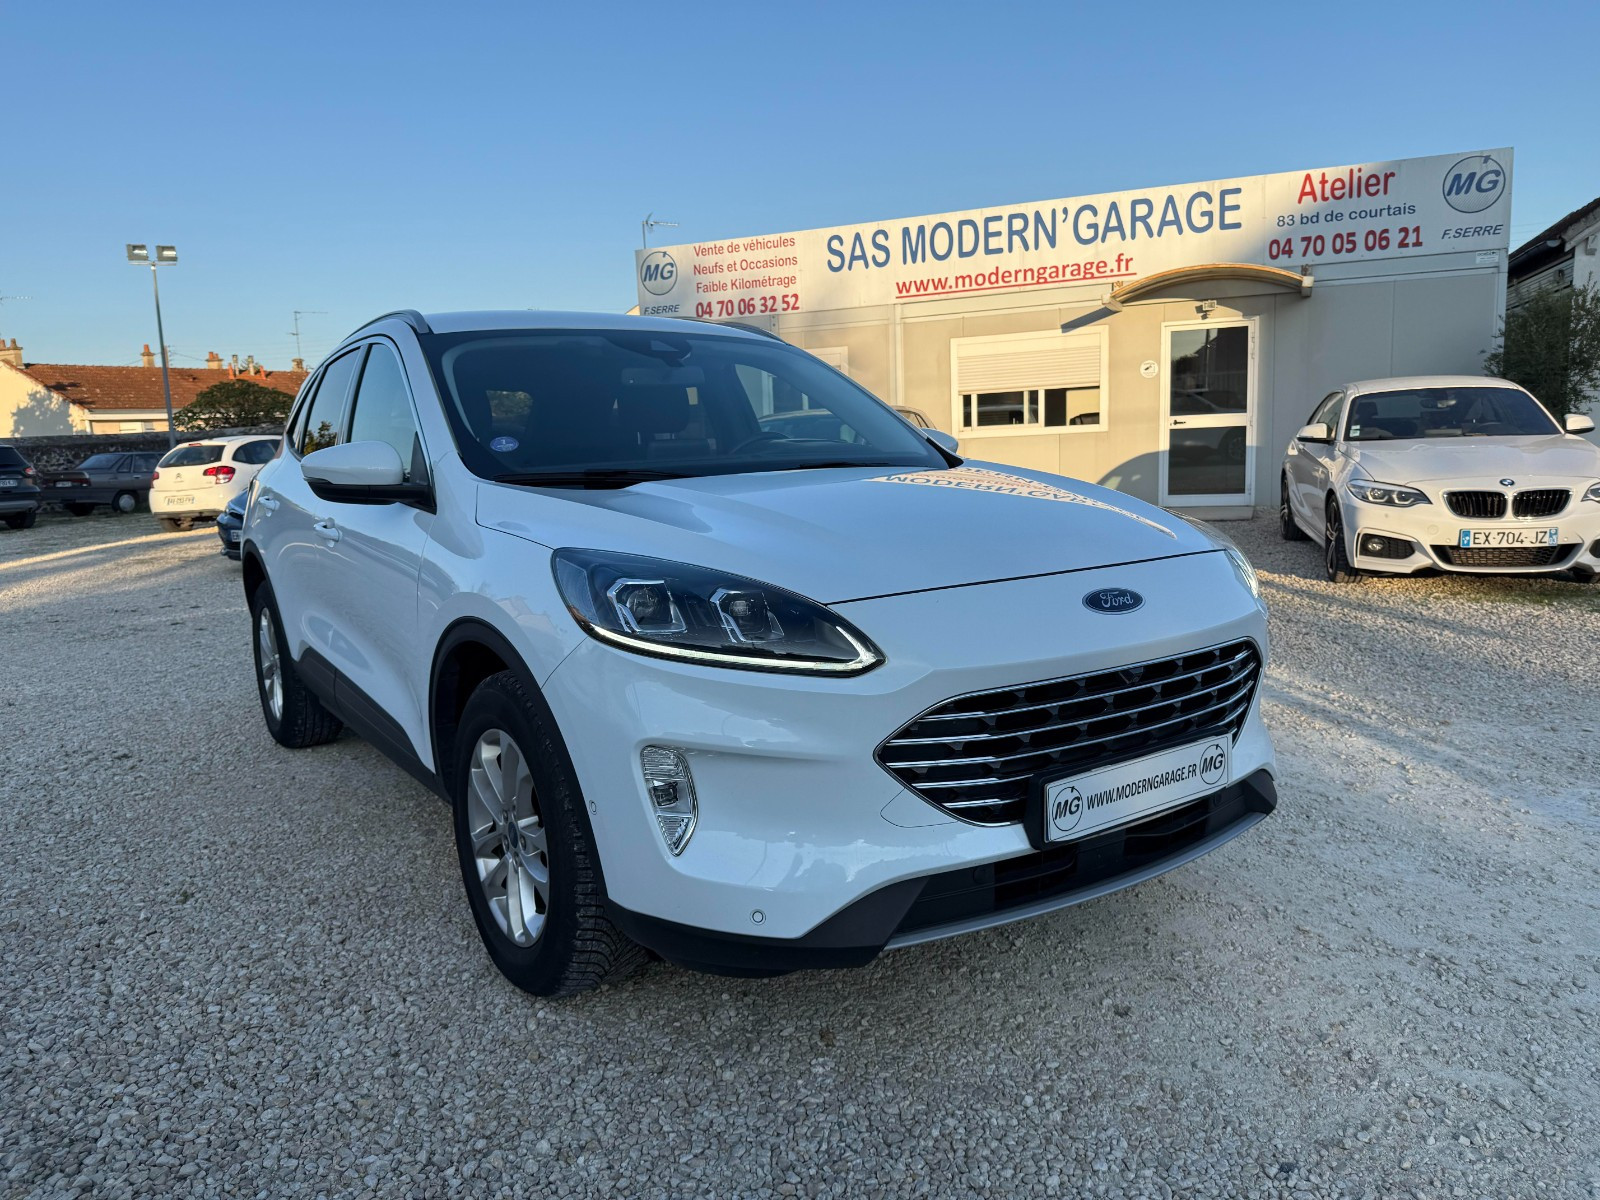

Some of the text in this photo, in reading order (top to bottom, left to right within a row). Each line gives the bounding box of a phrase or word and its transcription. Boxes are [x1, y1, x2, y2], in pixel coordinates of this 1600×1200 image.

[1297, 167, 1396, 204] Atelier
[1446, 169, 1501, 197] MG
[1276, 203, 1416, 227] 83 bd de courtais
[826, 187, 1242, 273] SAS MODERN'GARAGE
[1441, 224, 1504, 240] F.SERRE
[693, 236, 796, 257] Vente de véhicules
[1268, 225, 1423, 260] 04 70 05 06 21
[643, 262, 675, 282] MG
[693, 256, 798, 276] Neufs et Occasions
[895, 252, 1134, 295] www.moderngarage.fr
[696, 274, 797, 294] Faible Kilométrage
[644, 304, 680, 315] F.SERRE
[696, 293, 800, 318] 04 70 06 32 52
[1099, 591, 1134, 608] Ford
[1201, 752, 1224, 775] MG
[1086, 763, 1198, 811] WWW.MODERNGARAGE.FR
[1054, 796, 1081, 821] MG
